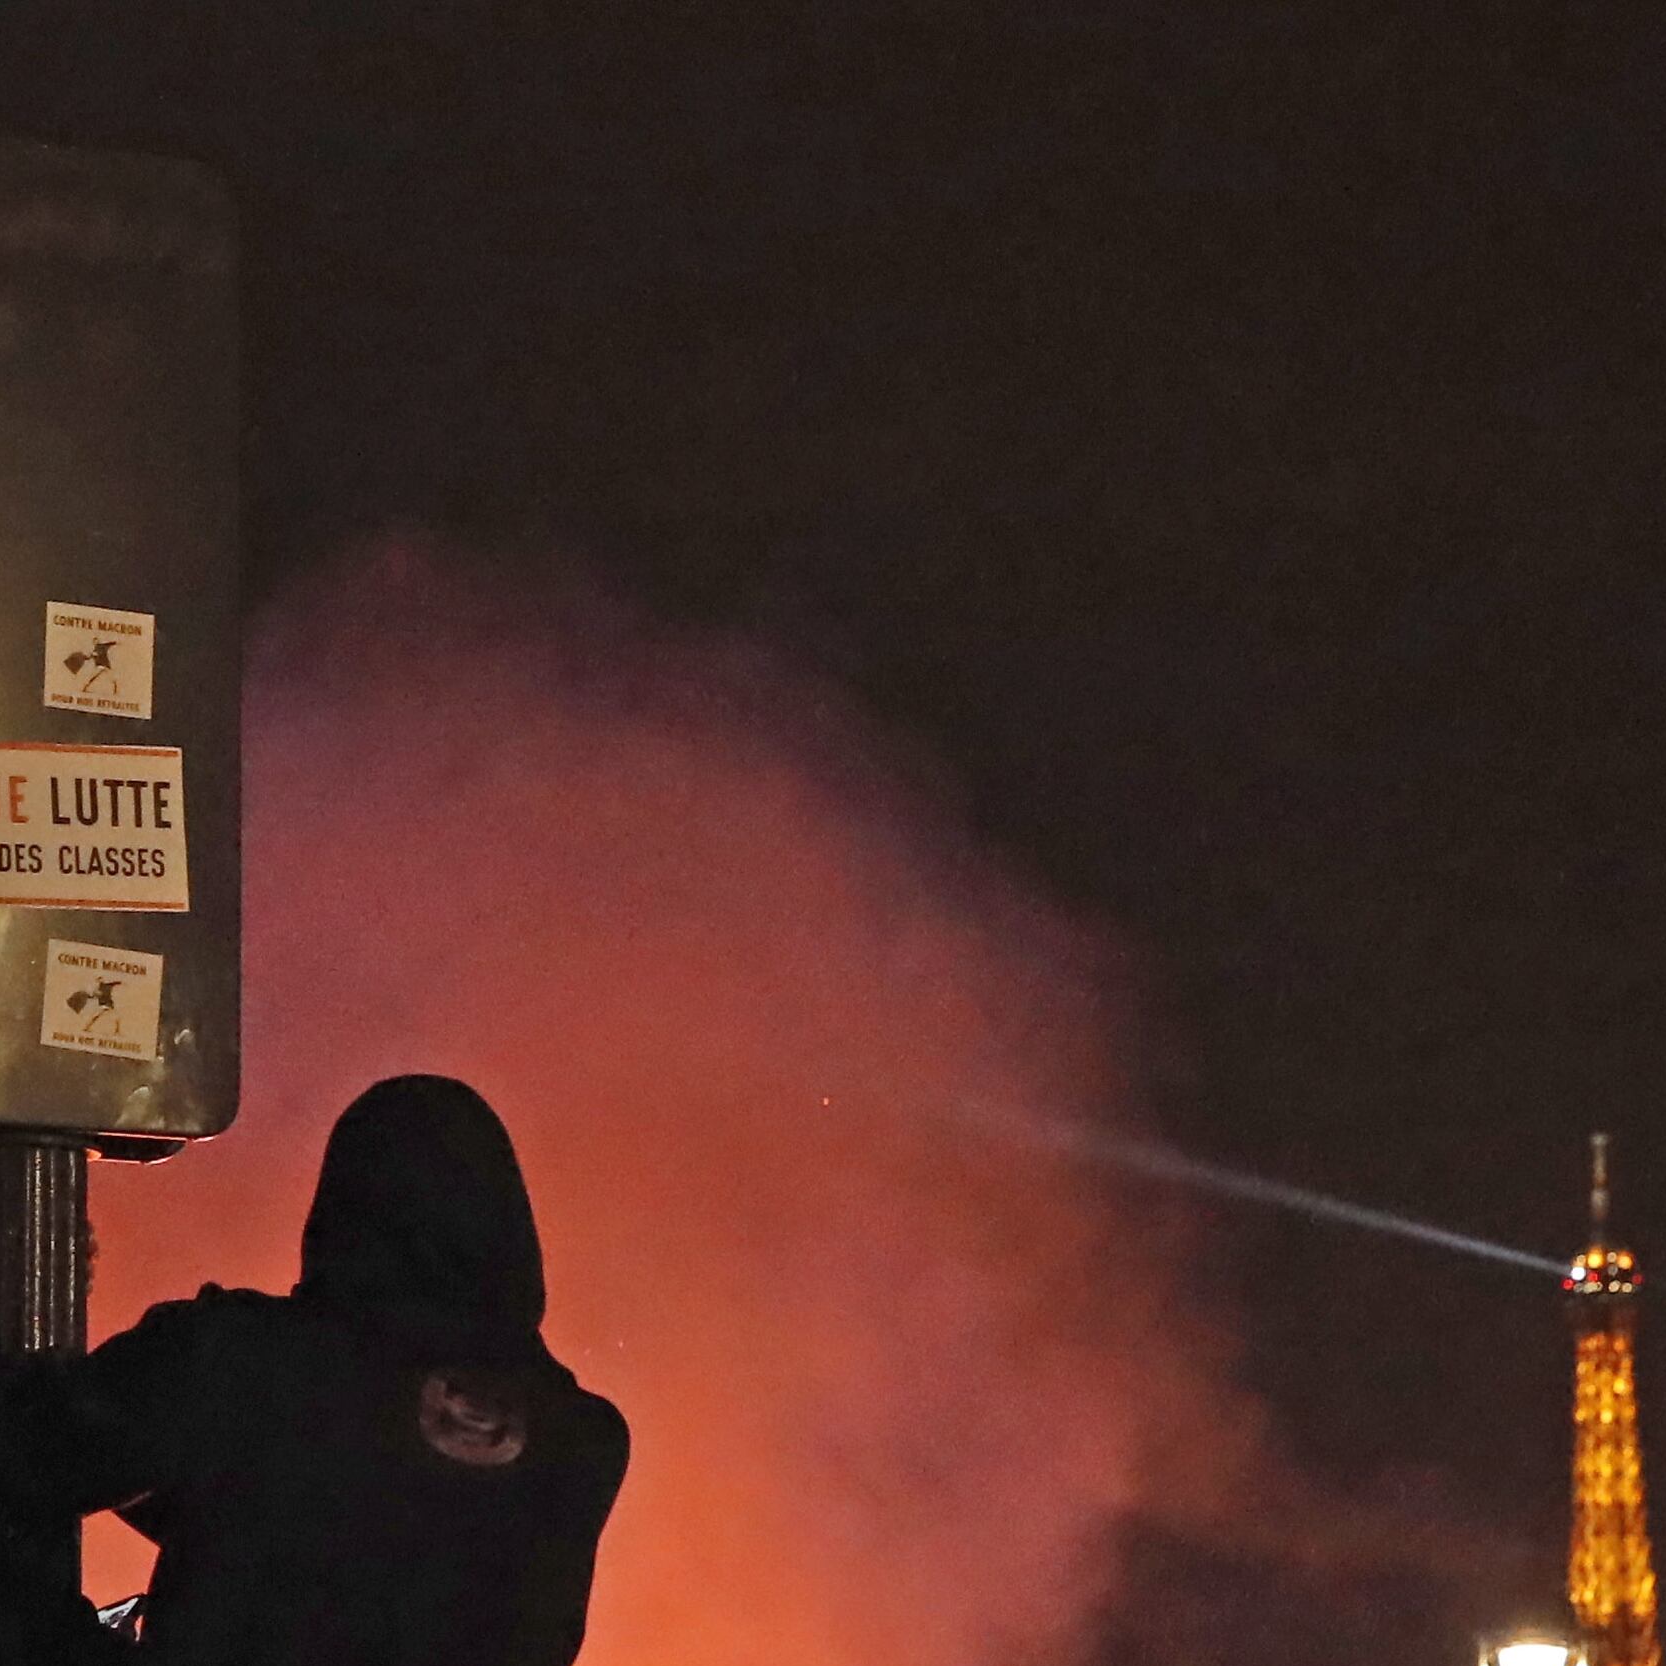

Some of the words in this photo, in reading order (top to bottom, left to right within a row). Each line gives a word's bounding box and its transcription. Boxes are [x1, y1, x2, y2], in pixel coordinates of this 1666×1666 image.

[53, 615, 93, 630] CONTRE
[98, 621, 142, 636] MACRON
[50, 776, 172, 829] LUTTE
[59, 845, 166, 878] CLASSES
[58, 954, 97, 969] CONTRE
[102, 961, 146, 975] MACRON
